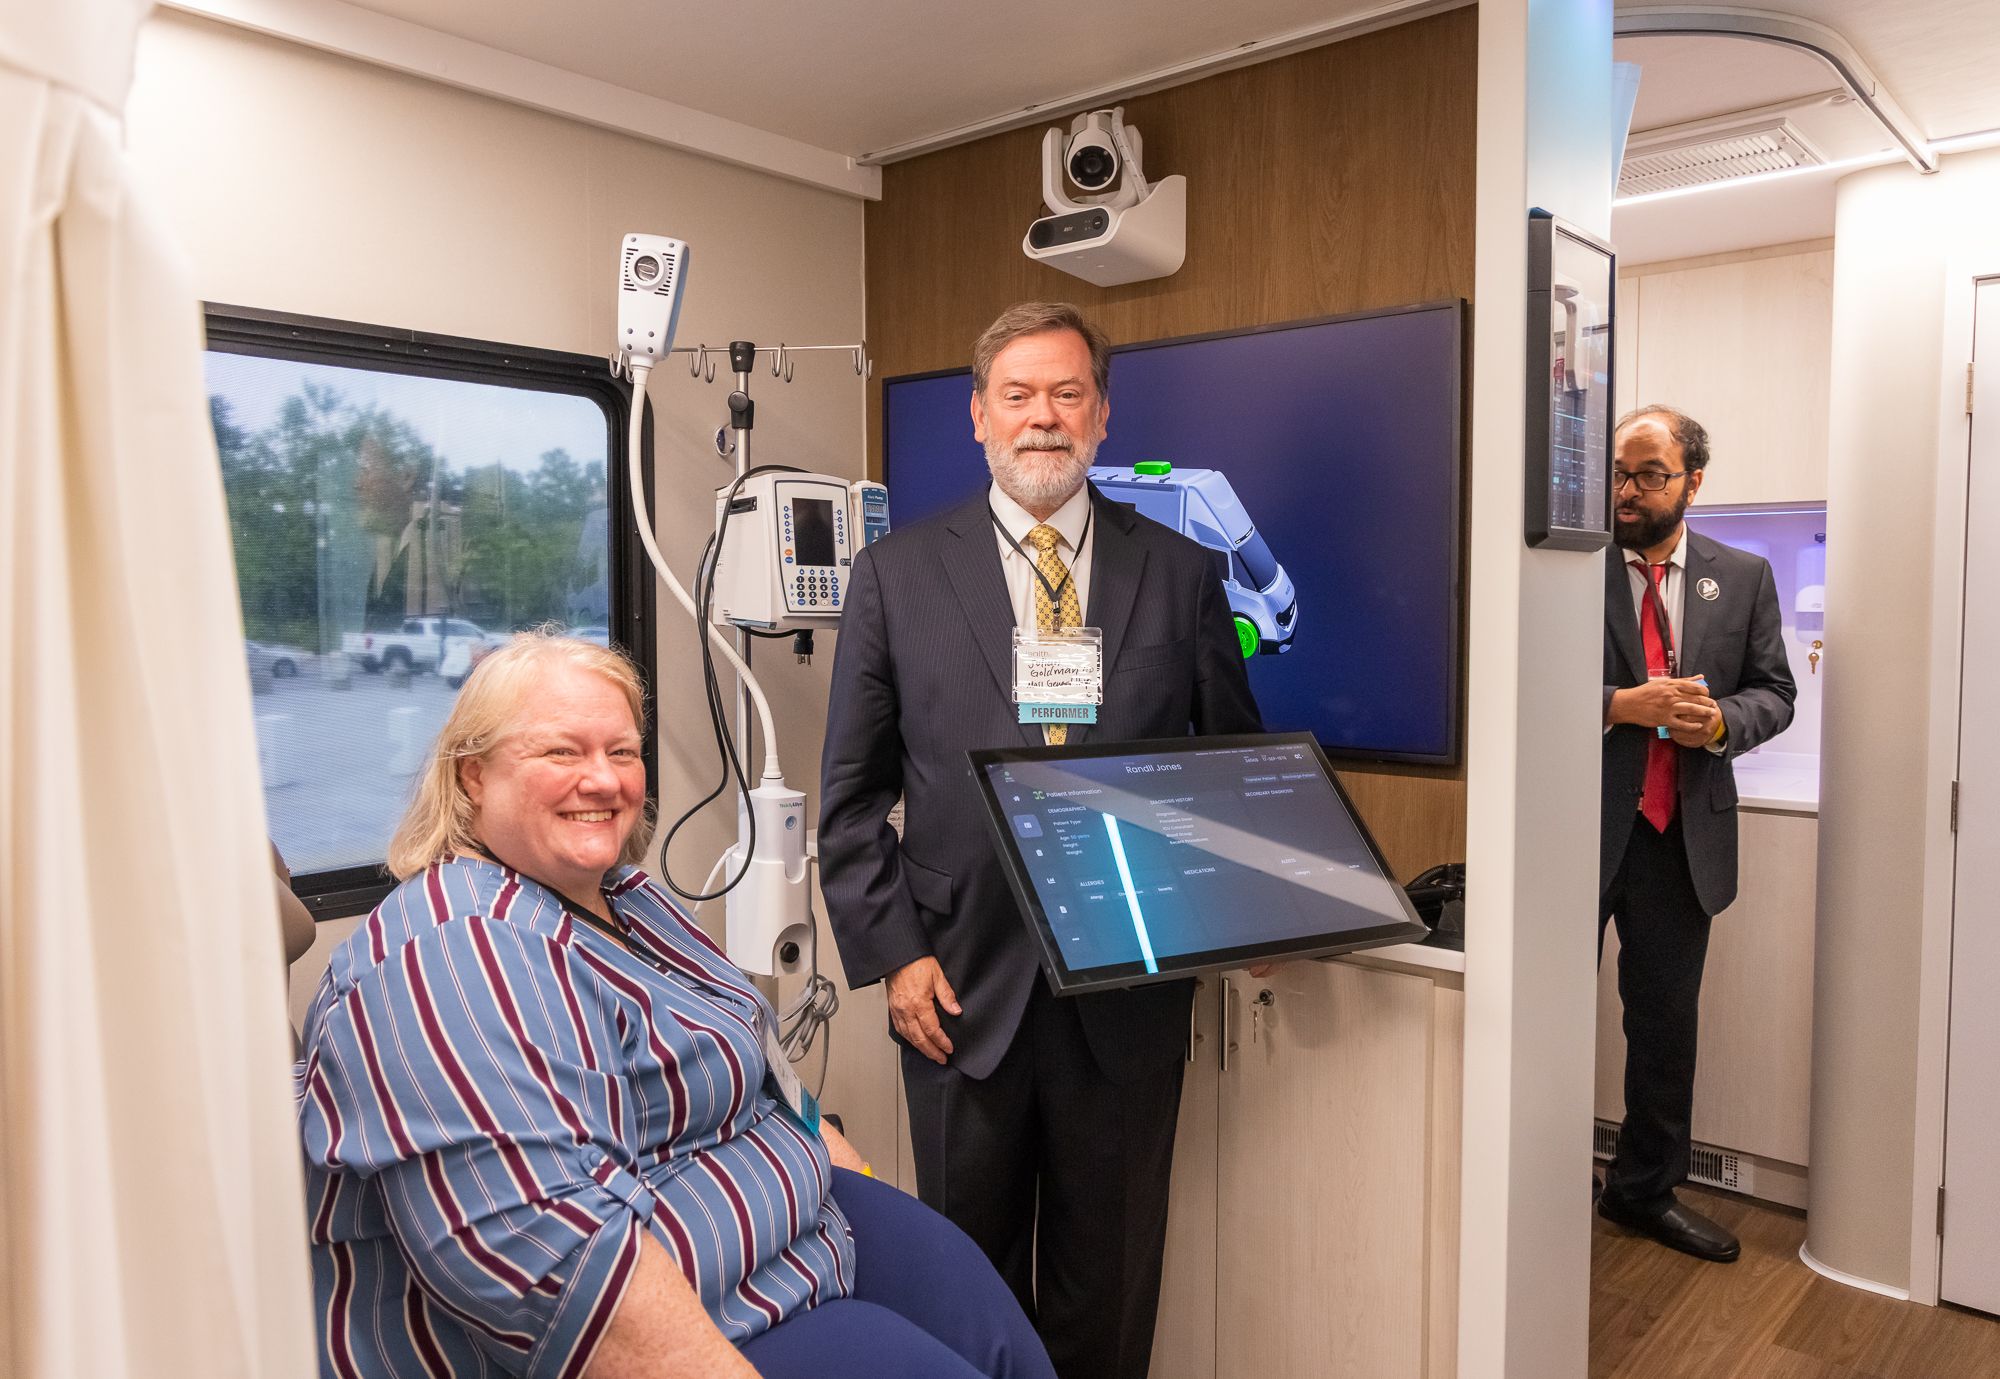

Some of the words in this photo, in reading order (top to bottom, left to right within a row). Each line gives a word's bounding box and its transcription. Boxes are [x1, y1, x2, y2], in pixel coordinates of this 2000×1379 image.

[1031, 666, 1079, 678] Goldman
[1031, 707, 1089, 719] PERFORMER
[1156, 763, 1182, 772] Jones
